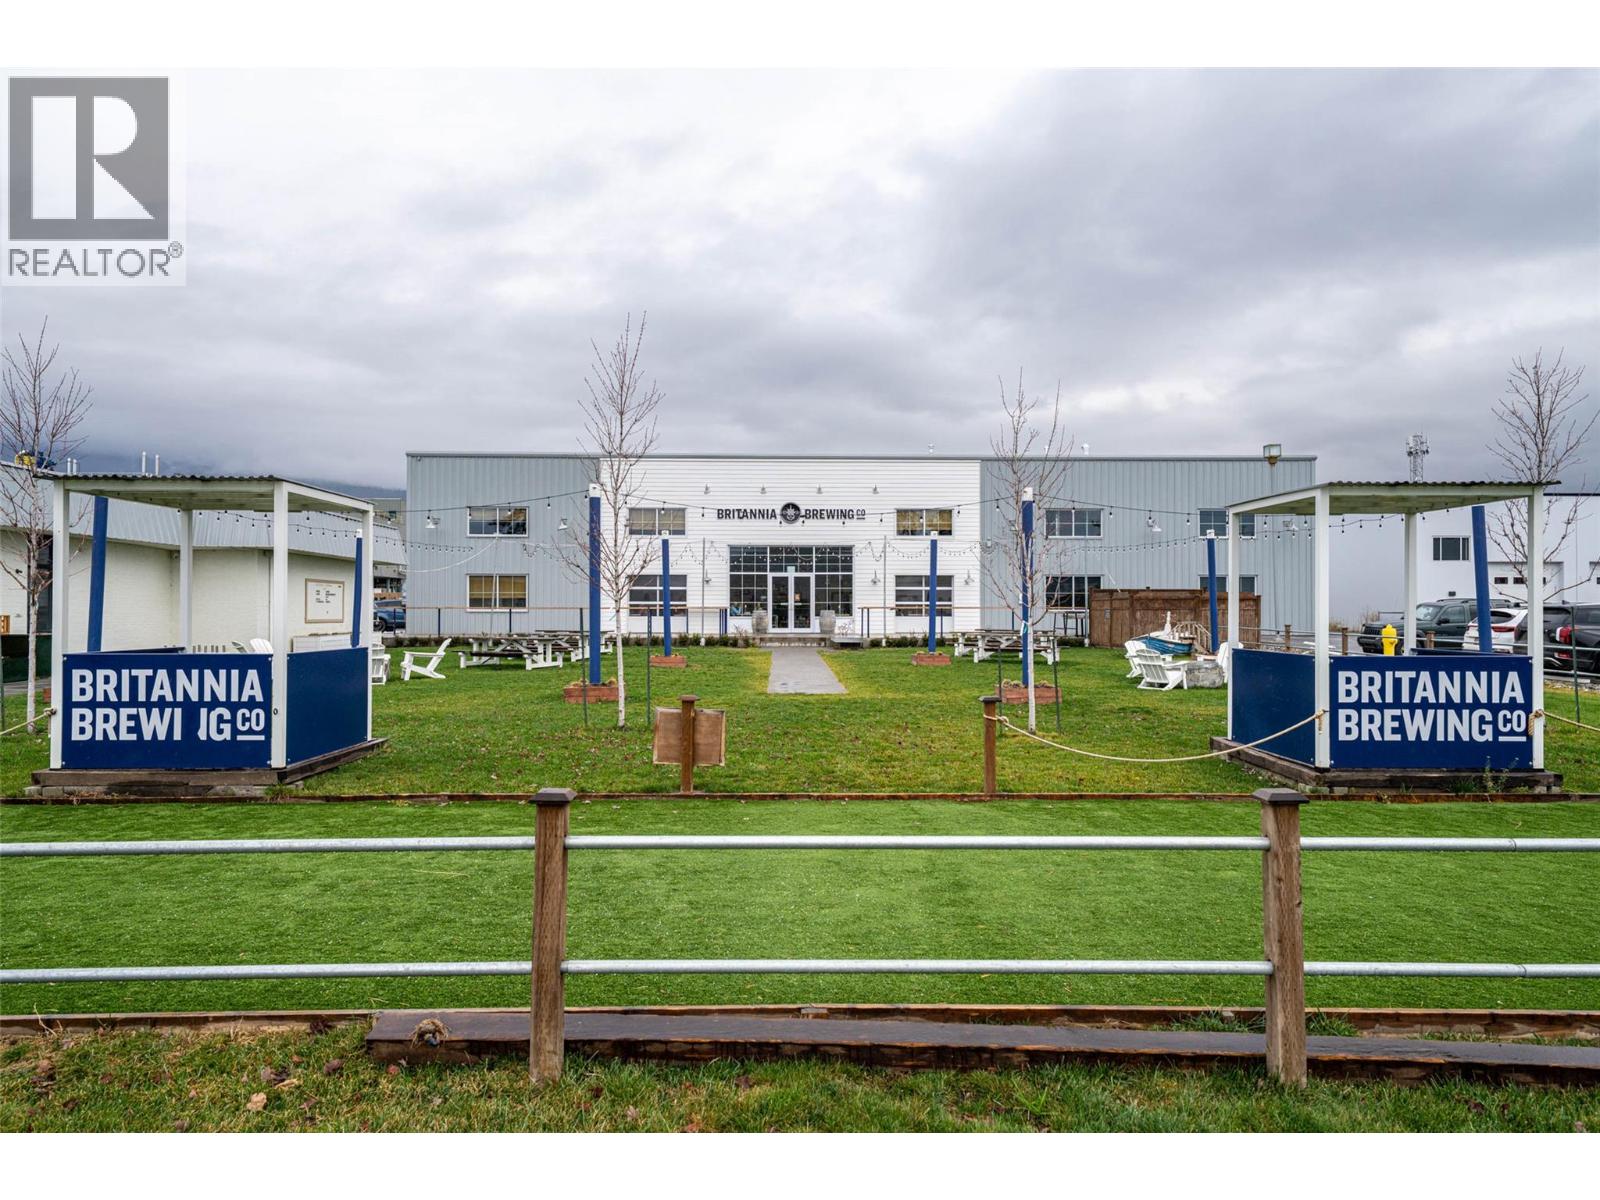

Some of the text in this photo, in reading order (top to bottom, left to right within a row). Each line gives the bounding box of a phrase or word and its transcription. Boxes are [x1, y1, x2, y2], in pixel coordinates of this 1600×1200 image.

[716, 508, 866, 520] BRITANNIA BREWING CO
[71, 669, 264, 702] BRITANNIA
[1337, 671, 1525, 704] BRITANNIA
[236, 708, 265, 731] CO
[1337, 708, 1526, 742] BREWING CO
